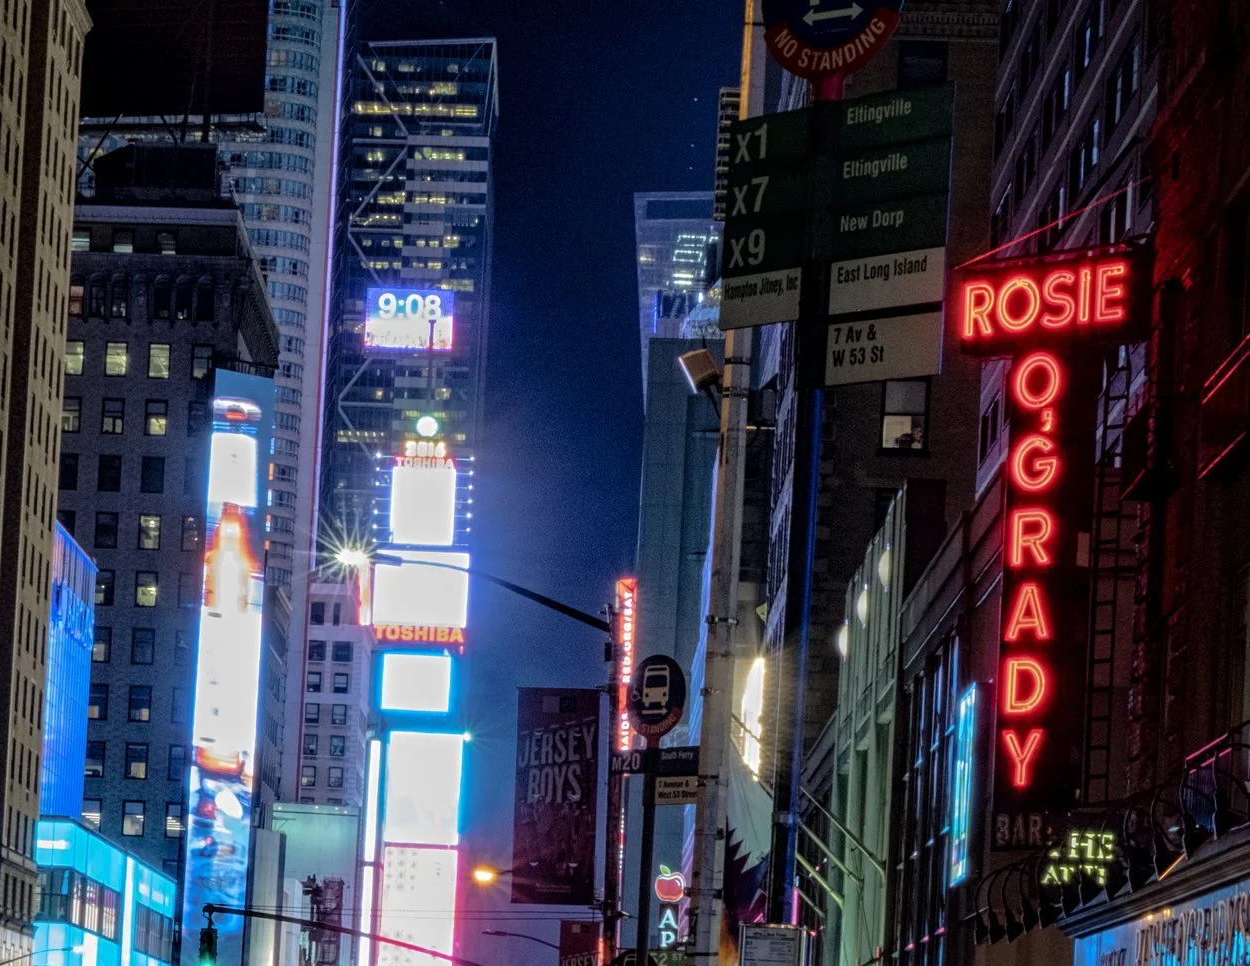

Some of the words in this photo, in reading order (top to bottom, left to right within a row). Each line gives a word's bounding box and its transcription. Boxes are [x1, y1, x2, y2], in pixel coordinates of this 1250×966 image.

[774, 29, 798, 58] NO
[798, 18, 886, 71] STANDING
[847, 99, 912, 125] Eltingville
[843, 153, 908, 180] Eltingville
[840, 215, 868, 233] New
[872, 209, 904, 228] Dorp
[837, 266, 860, 284] East
[864, 263, 890, 281] Long
[893, 256, 927, 276] Island
[724, 281, 758, 301] Hampton
[785, 274, 799, 292] Inc
[963, 261, 1125, 337] ROSIE
[378, 293, 442, 320] 9:08
[834, 327, 842, 344] 7
[846, 325, 863, 343] Av
[867, 323, 877, 341] &
[832, 349, 846, 366] W
[849, 347, 866, 365] 53
[870, 345, 885, 363] St
[1002, 352, 1060, 790] O'GRADY
[374, 625, 464, 643] TOSHIBA
[516, 723, 597, 768] JERSEY
[611, 753, 641, 772] M20
[527, 763, 582, 804] BOYS
[996, 813, 1043, 846] BAR
[1048, 832, 1114, 859] HE
